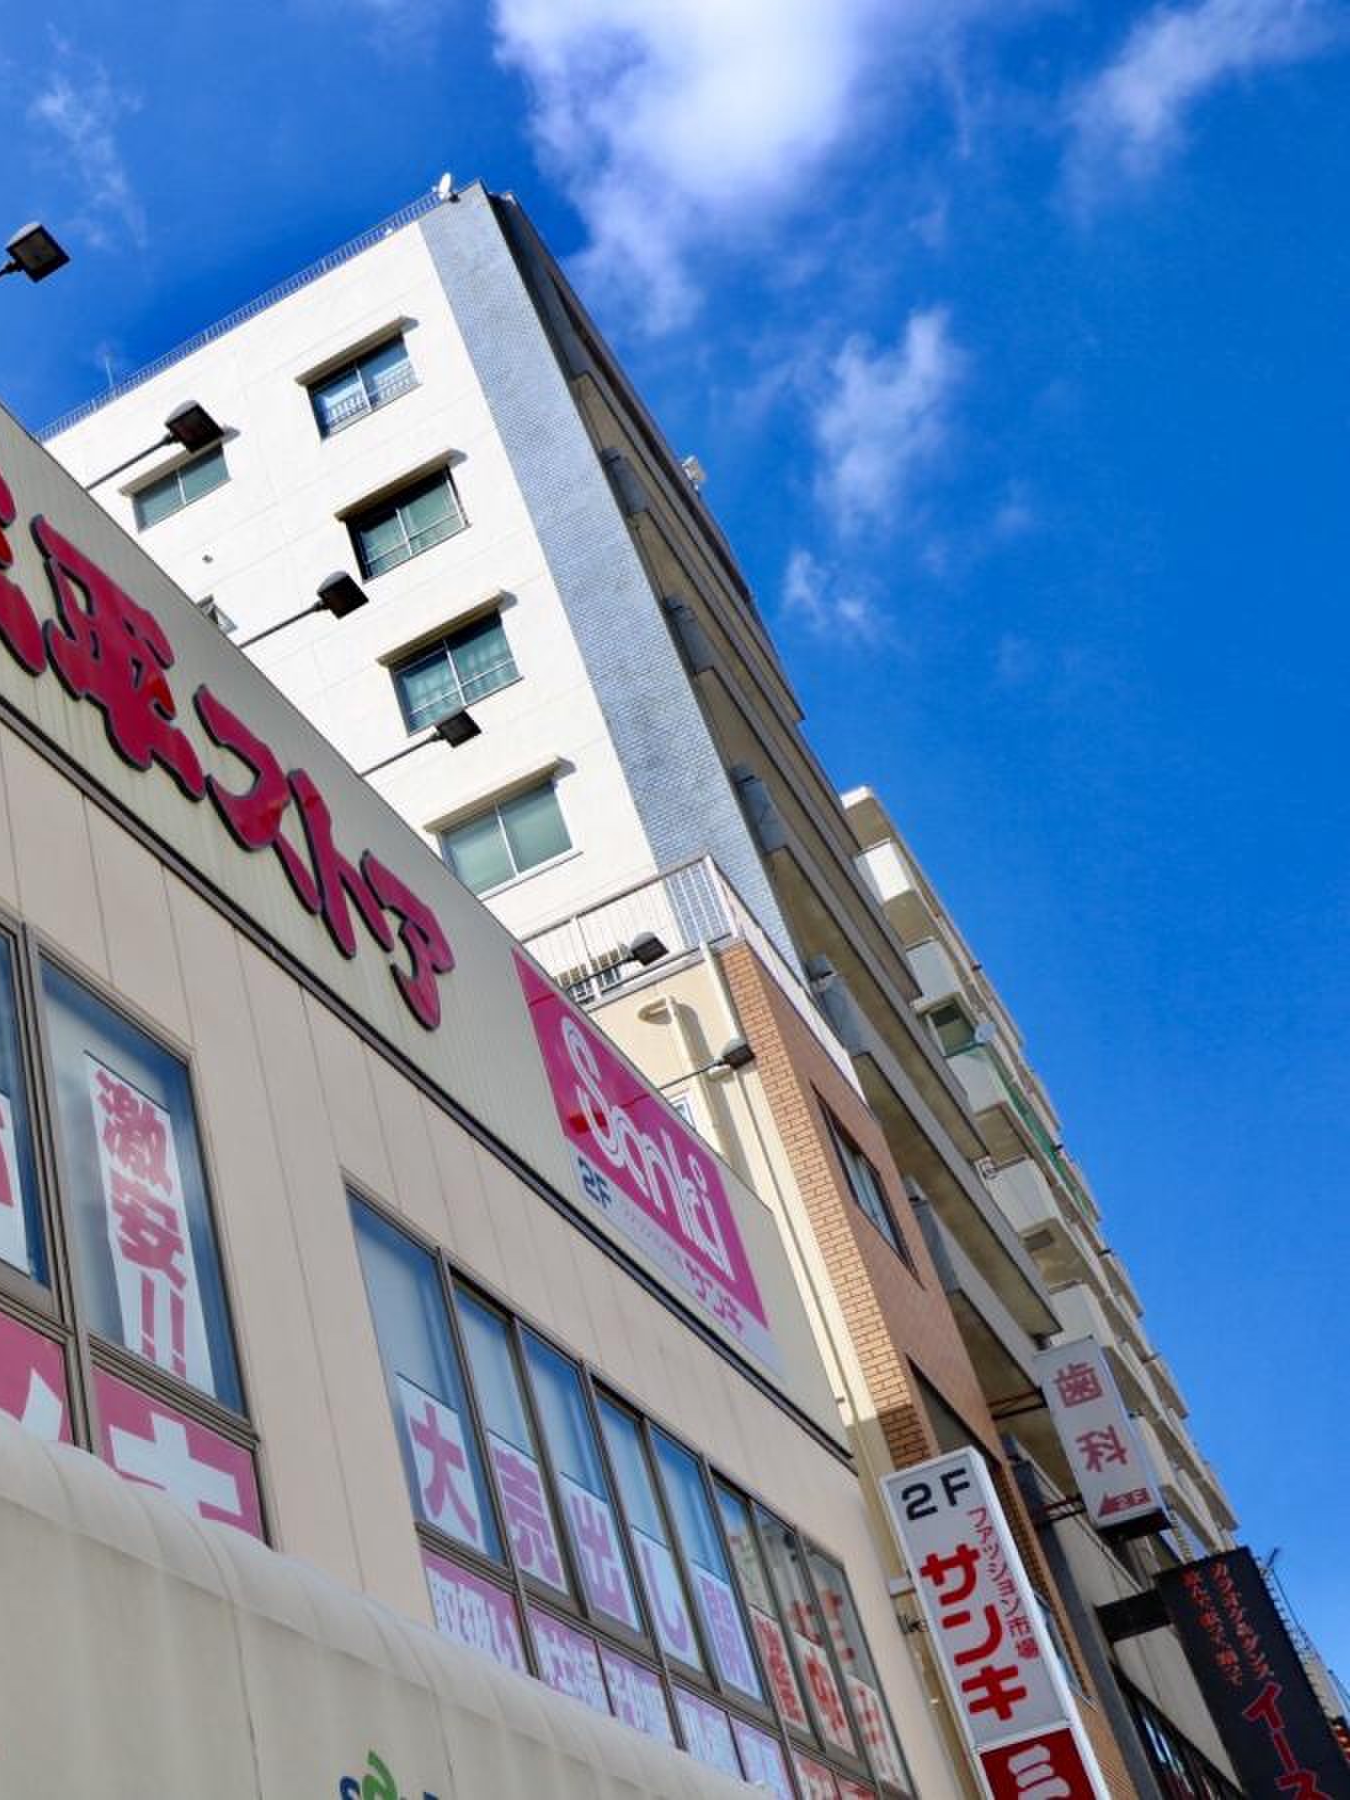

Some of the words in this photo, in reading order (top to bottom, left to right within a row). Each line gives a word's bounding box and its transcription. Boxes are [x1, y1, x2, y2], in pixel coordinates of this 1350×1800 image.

[1053, 1363, 1128, 1472] 歯科
[901, 1468, 970, 1520] 2F
[920, 1544, 1027, 1720] サンキ
